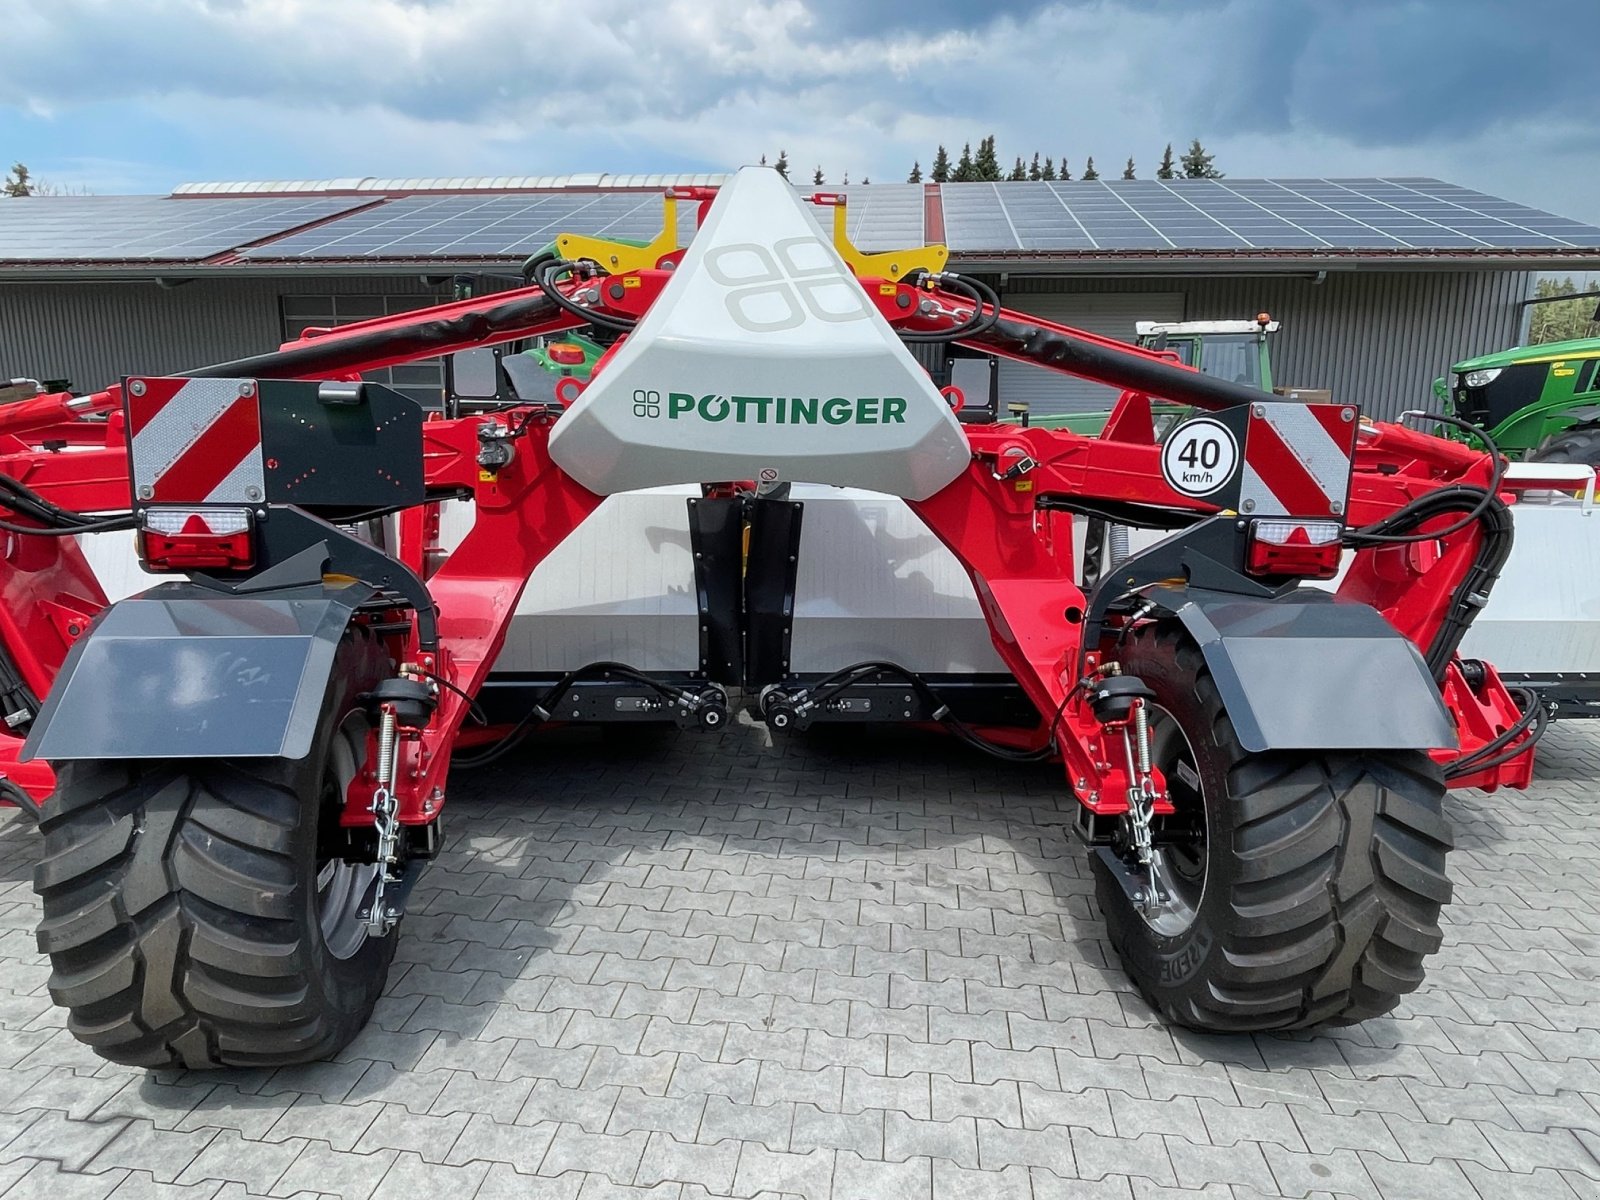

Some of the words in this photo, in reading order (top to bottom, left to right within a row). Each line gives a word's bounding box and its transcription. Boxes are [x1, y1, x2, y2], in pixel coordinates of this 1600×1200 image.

[668, 392, 908, 425] PÖTTINGER
[1178, 438, 1220, 469] 40
[1182, 471, 1213, 483] km/h
